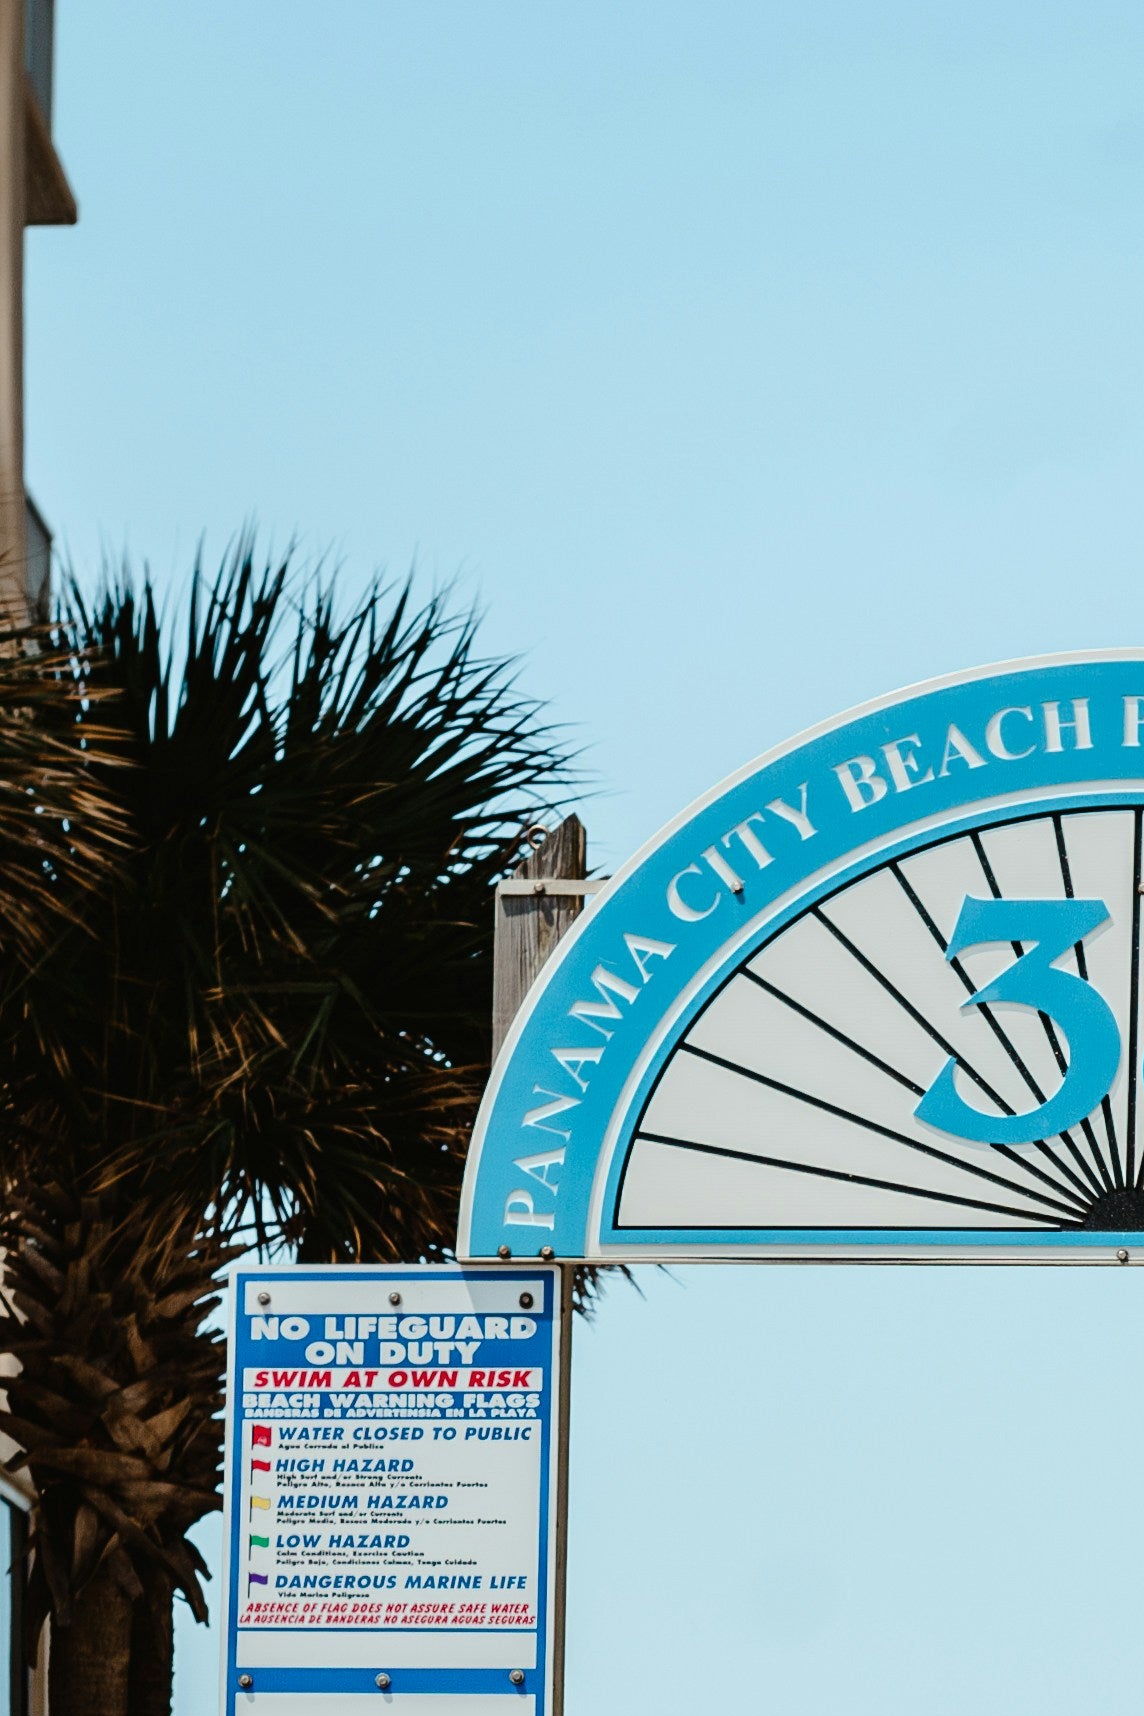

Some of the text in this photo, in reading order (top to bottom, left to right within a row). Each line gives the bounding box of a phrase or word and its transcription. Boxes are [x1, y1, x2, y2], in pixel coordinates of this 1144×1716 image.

[503, 932, 677, 1232] PANAMA
[666, 784, 818, 923] CITY
[833, 698, 1094, 814] BEACH
[250, 1316, 537, 1340] NO LIFEGUARD
[304, 1341, 480, 1365] ON DUTY
[254, 1370, 531, 1387] SWIM AT OWN RISK
[242, 1393, 540, 1409] BEACH WARNING FLAGS
[279, 1426, 531, 1440] WATER CLOSED TO PUBLIC
[275, 1458, 414, 1474] HIGH HAZARD
[277, 1495, 448, 1509] MEDIUM HAZARD
[276, 1534, 410, 1548] LOW HAZARD
[275, 1575, 527, 1589] DANGEROUS MARINE LIFE
[246, 1602, 529, 1615] ABSENCE OF FLAG DOES NOT ASSURE SAFE WATER
